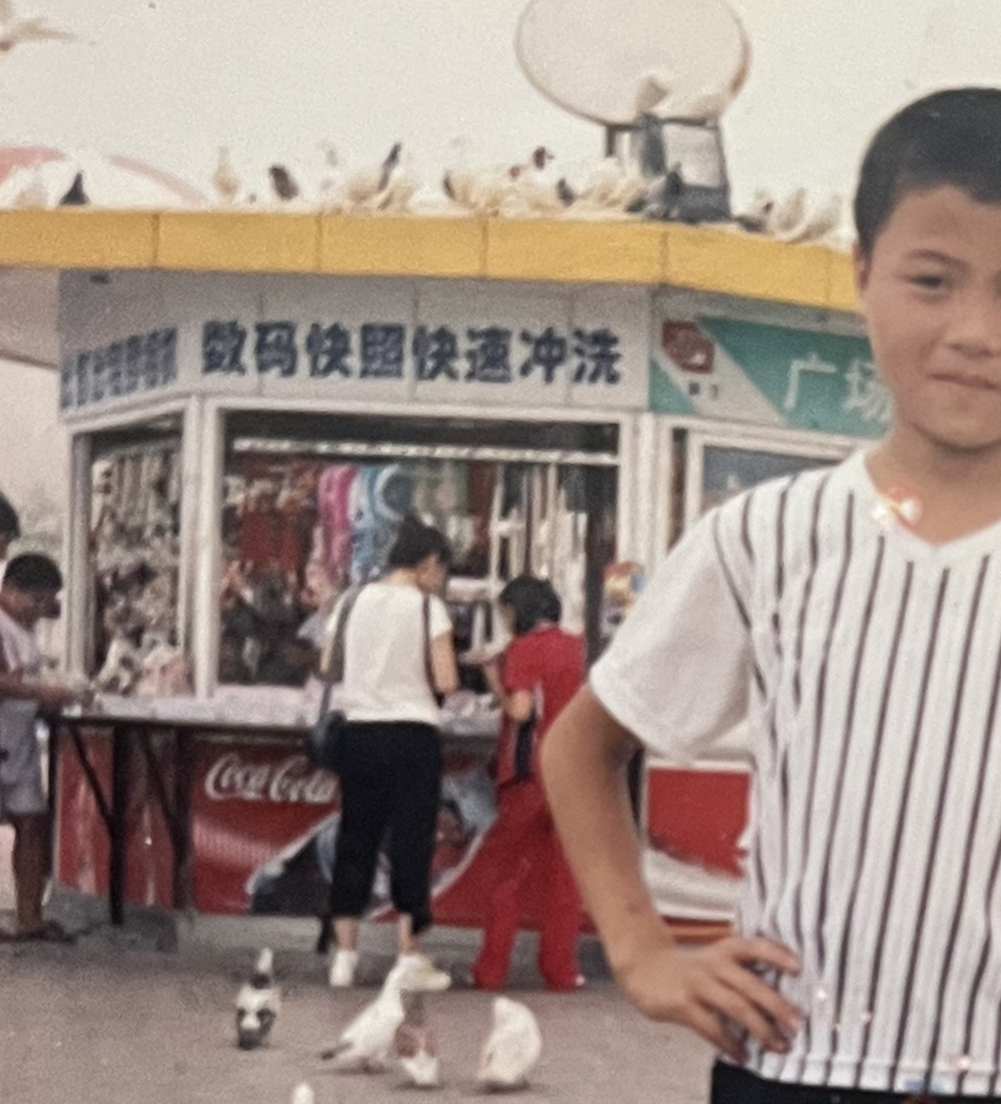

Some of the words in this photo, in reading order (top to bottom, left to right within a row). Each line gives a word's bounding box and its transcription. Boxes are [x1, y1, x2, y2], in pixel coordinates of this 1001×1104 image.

[202, 320, 621, 384] 数码快照快速冲洗
